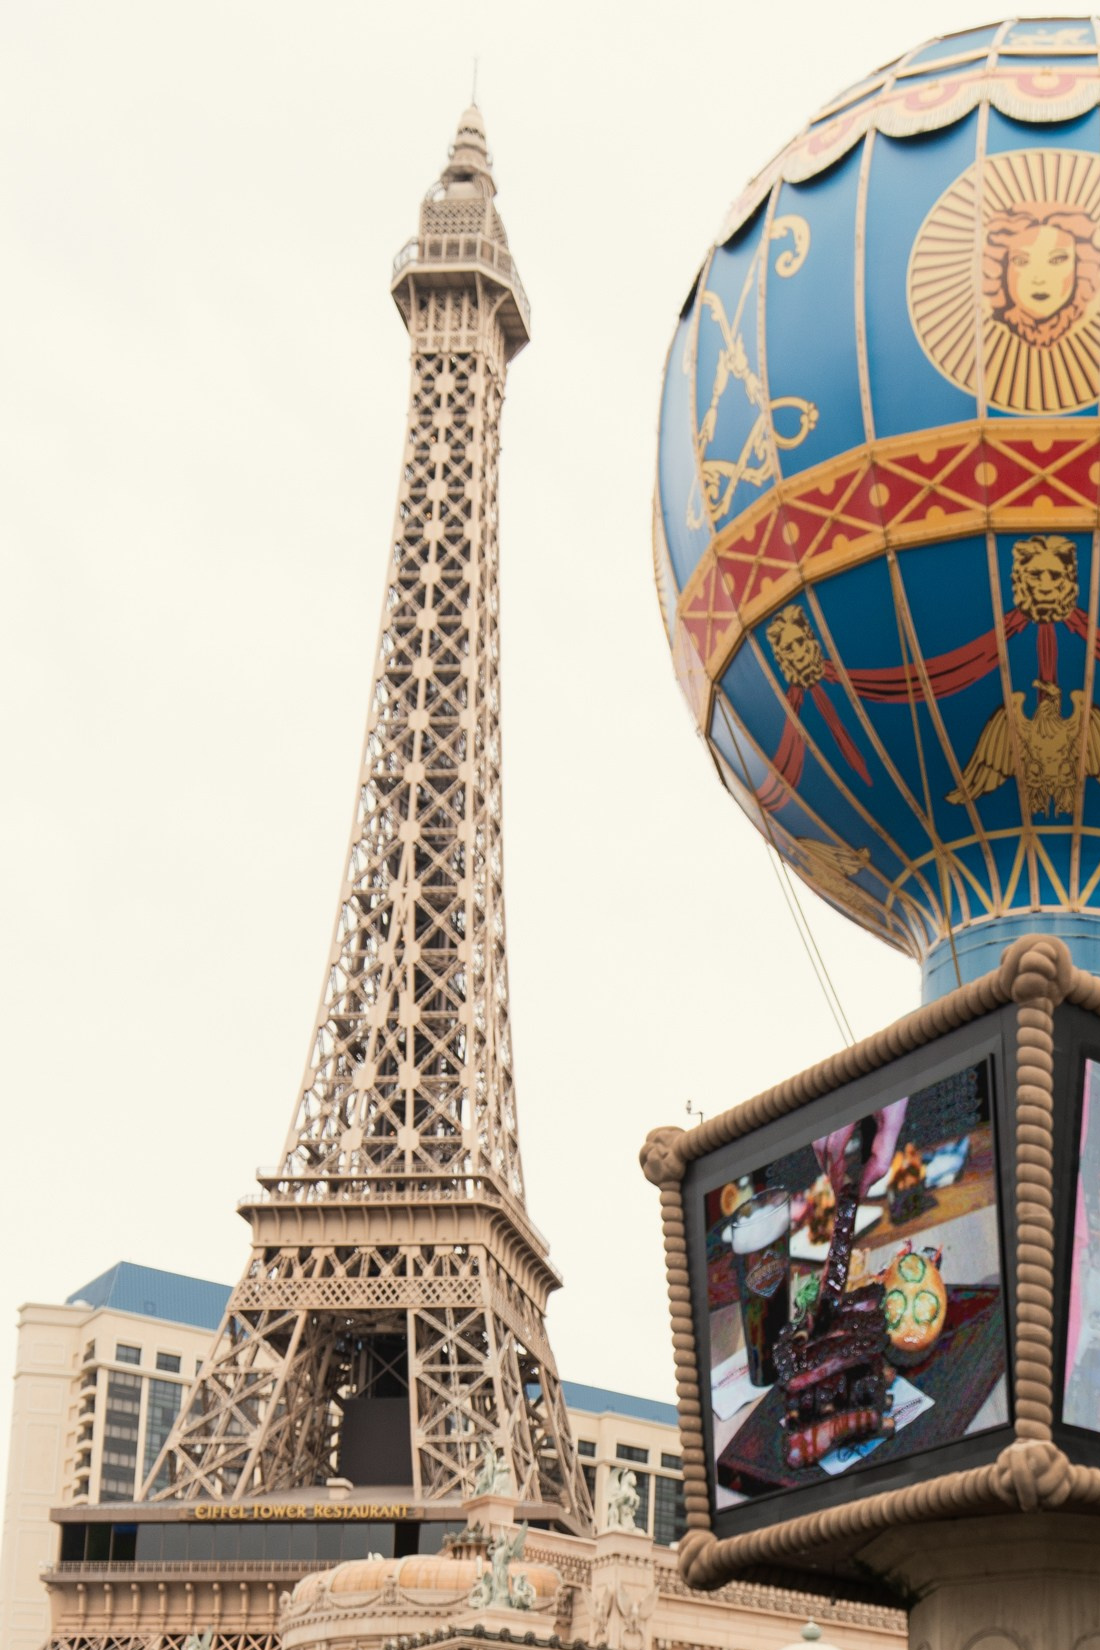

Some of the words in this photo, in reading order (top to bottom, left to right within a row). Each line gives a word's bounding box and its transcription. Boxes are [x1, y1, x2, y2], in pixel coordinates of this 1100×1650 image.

[195, 1504, 248, 1519] EIFFEL
[252, 1504, 306, 1519] TOWER
[314, 1503, 410, 1519] RESTAURANT
